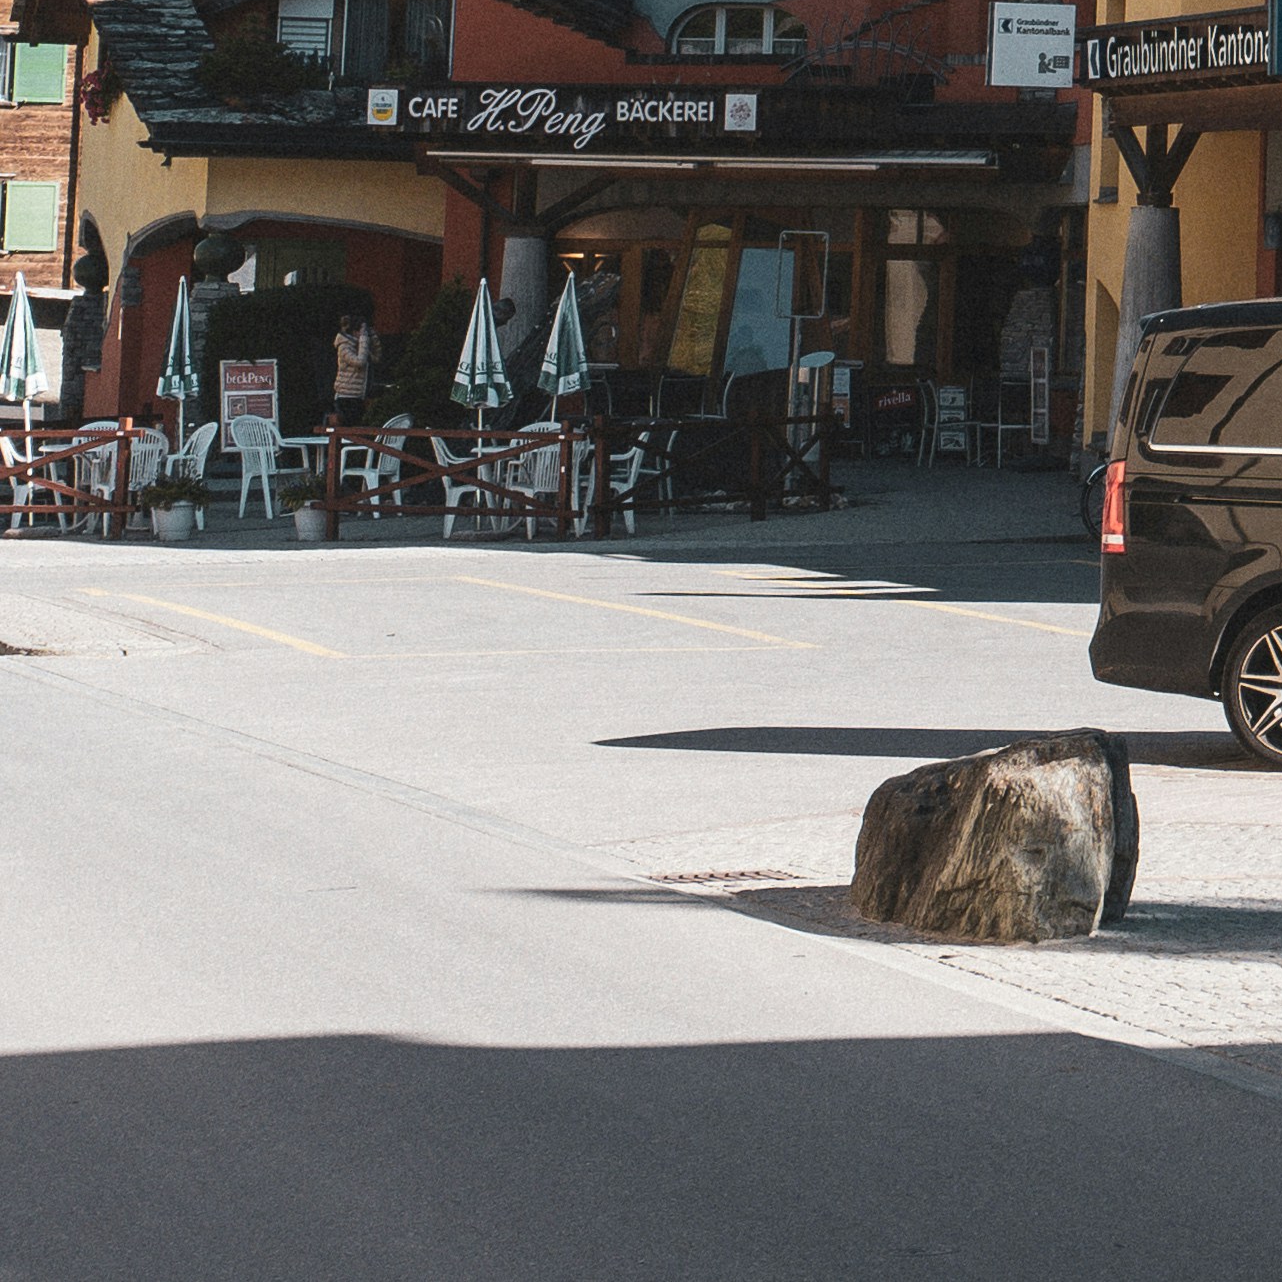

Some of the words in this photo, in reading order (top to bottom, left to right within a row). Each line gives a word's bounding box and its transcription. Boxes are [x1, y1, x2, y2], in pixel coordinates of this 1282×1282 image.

[1016, 17, 1060, 27] Graubündner
[1016, 26, 1071, 36] Kantonalbank
[1105, 25, 1203, 79] Graubündner
[407, 96, 459, 119] CAFE
[615, 97, 715, 123] BÄCKEREI
[878, 391, 912, 407] rivella
